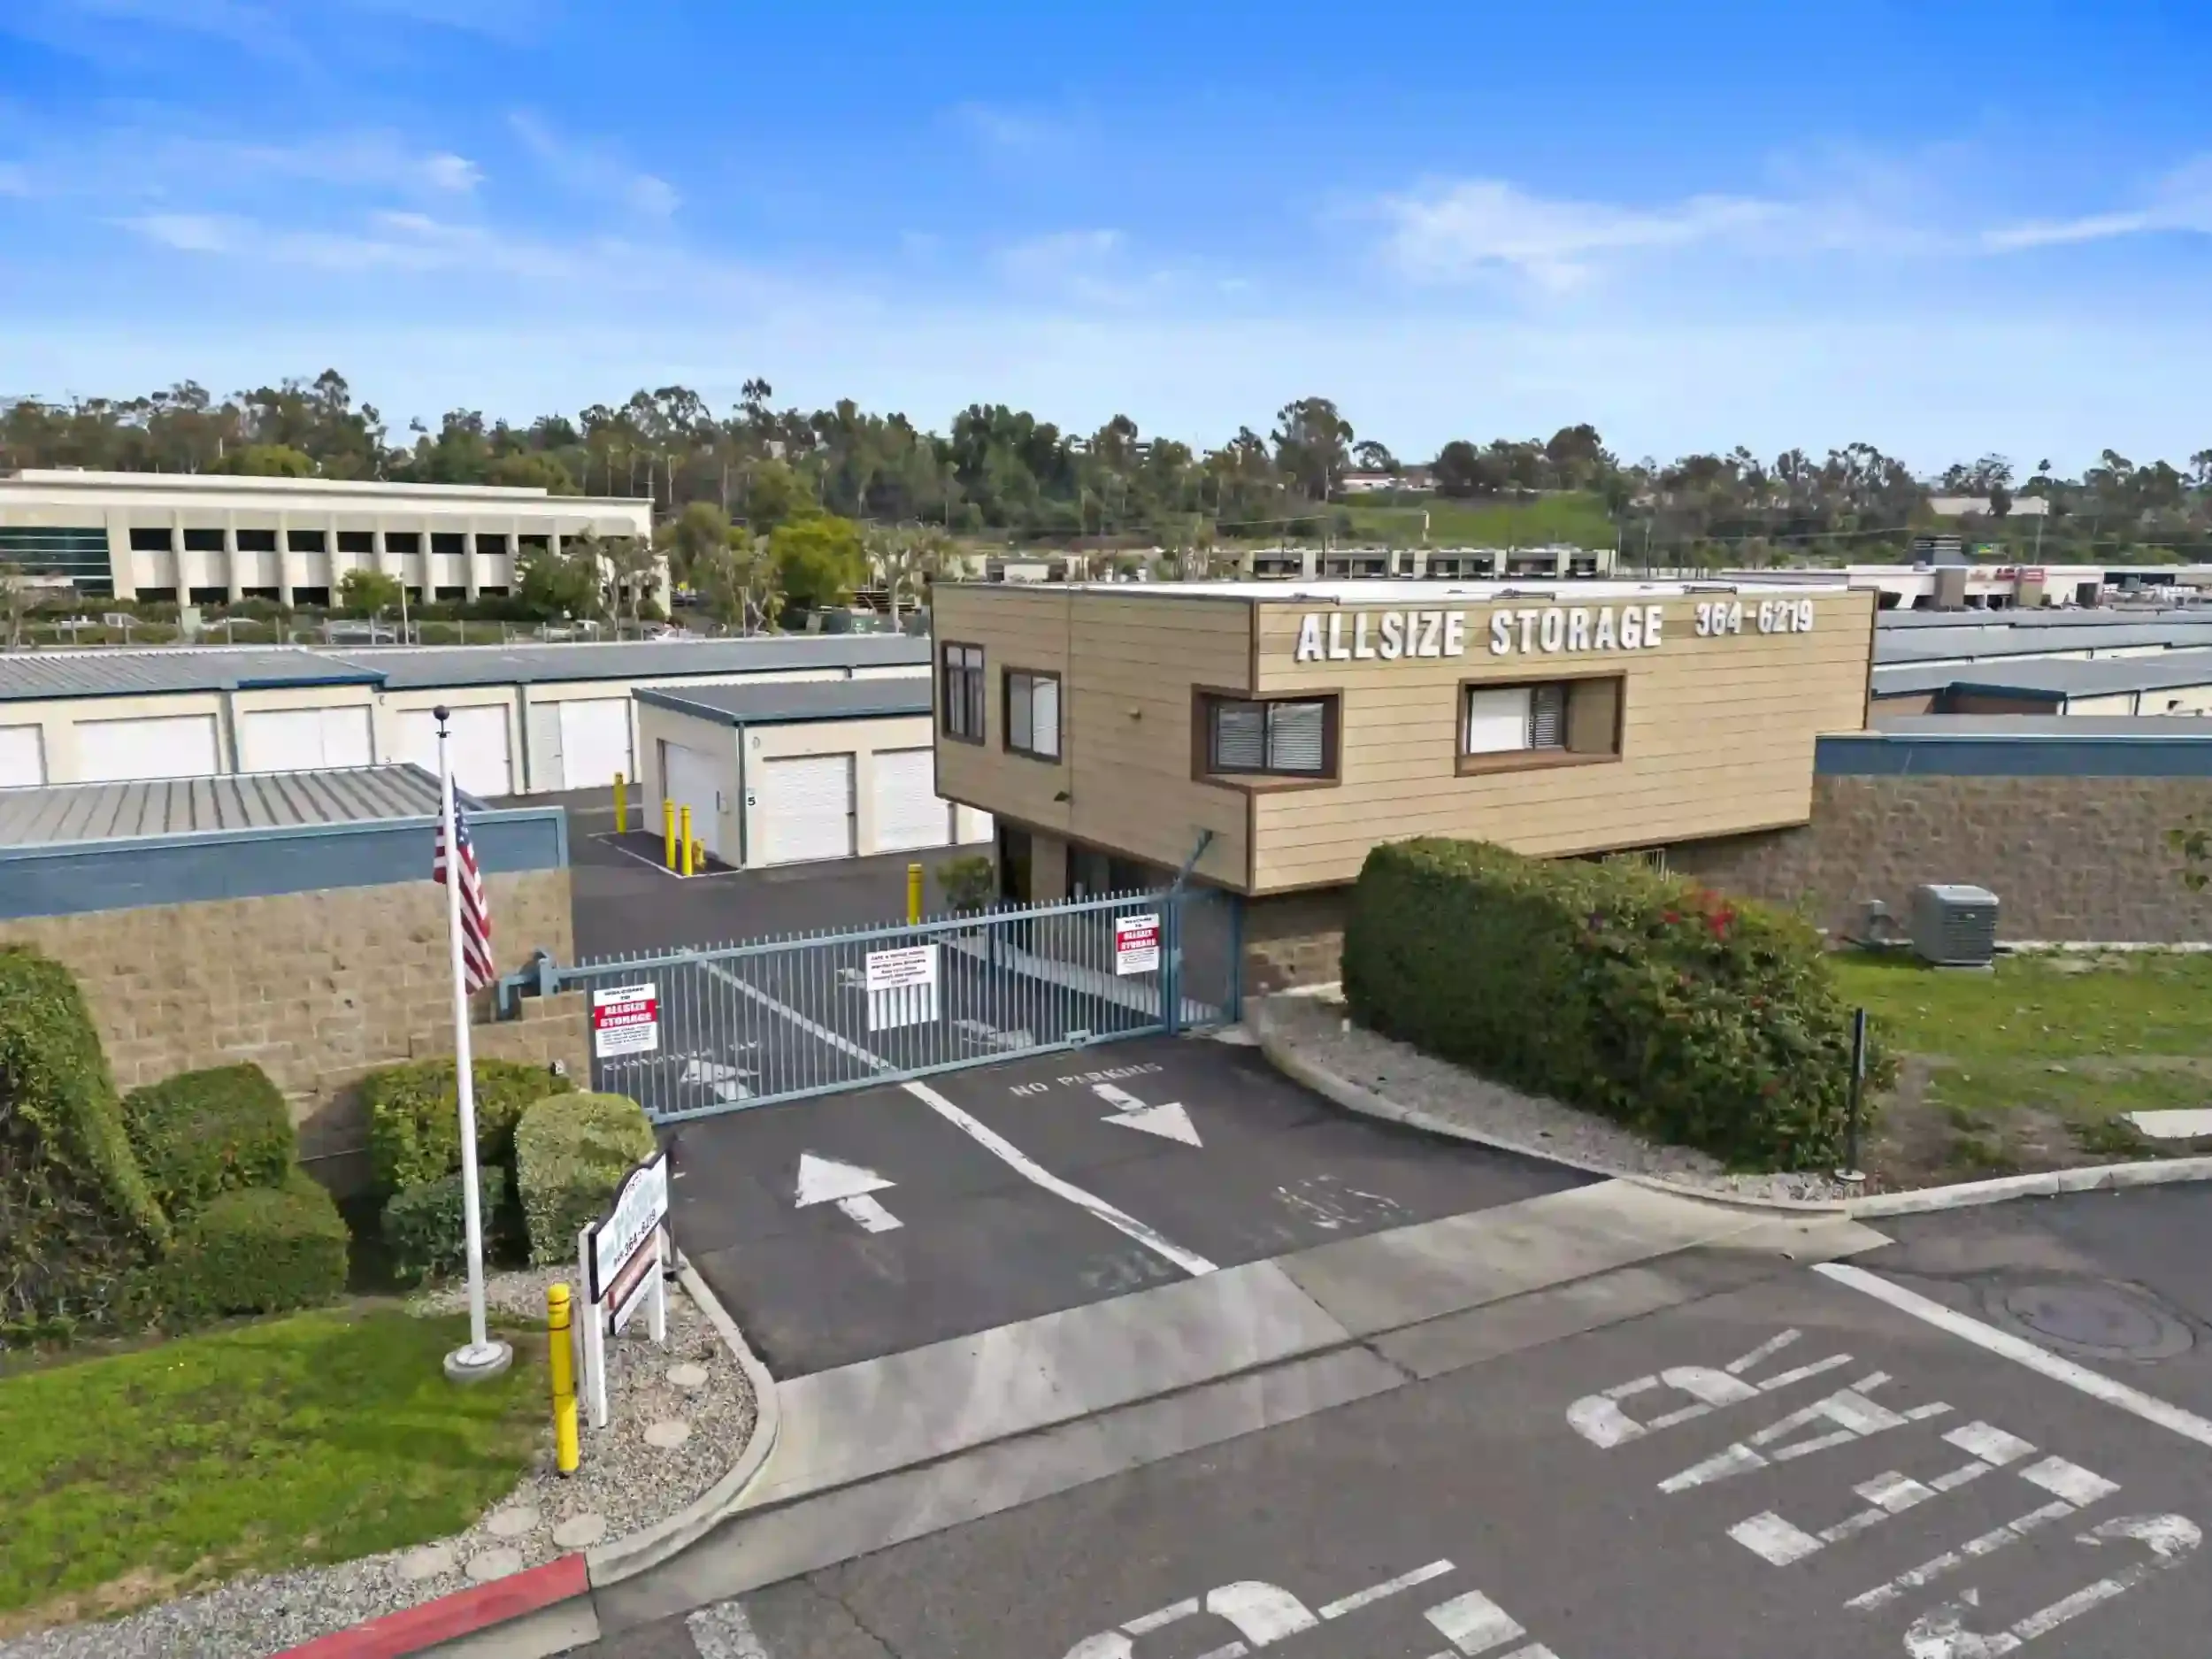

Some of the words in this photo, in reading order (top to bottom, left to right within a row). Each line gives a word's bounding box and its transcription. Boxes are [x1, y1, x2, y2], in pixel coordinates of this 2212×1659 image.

[1296, 610, 1465, 661] ALLSIZE
[1490, 605, 1663, 656] STORAGE
[1694, 600, 1814, 636] 364-6219
[600, 1012, 652, 1027] STORAGE
[1009, 1081, 1050, 1097] NO
[1056, 1062, 1164, 1087] PARKING
